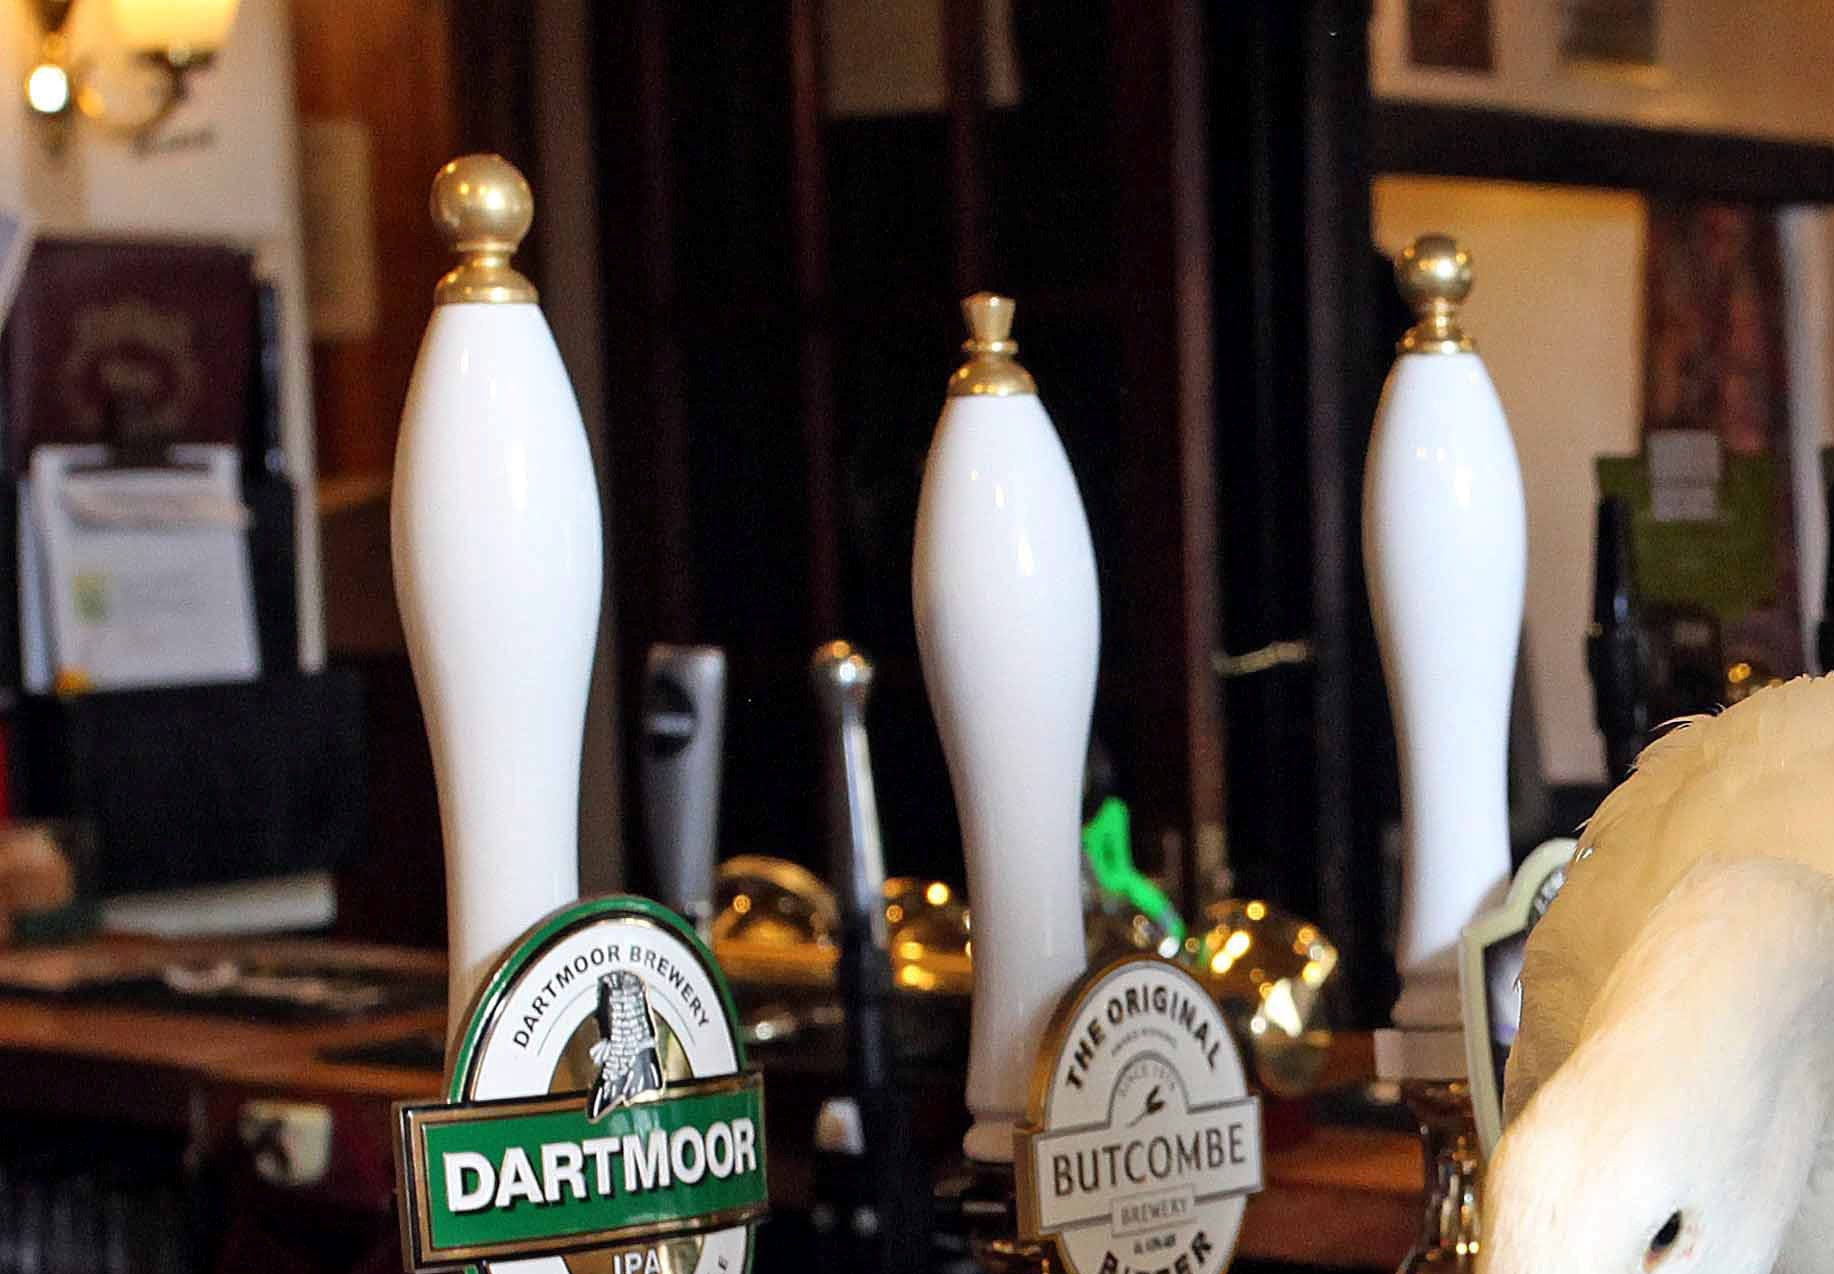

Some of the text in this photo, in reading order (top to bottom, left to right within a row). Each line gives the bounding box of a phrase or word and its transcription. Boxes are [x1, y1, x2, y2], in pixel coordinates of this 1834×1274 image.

[512, 944, 711, 1049] DARTMOOR BREWERY
[1066, 983, 1225, 1091] THE ORIGINAL
[442, 1117, 758, 1213] DARTMOOR
[1052, 1122, 1246, 1198] BUTCOMBE
